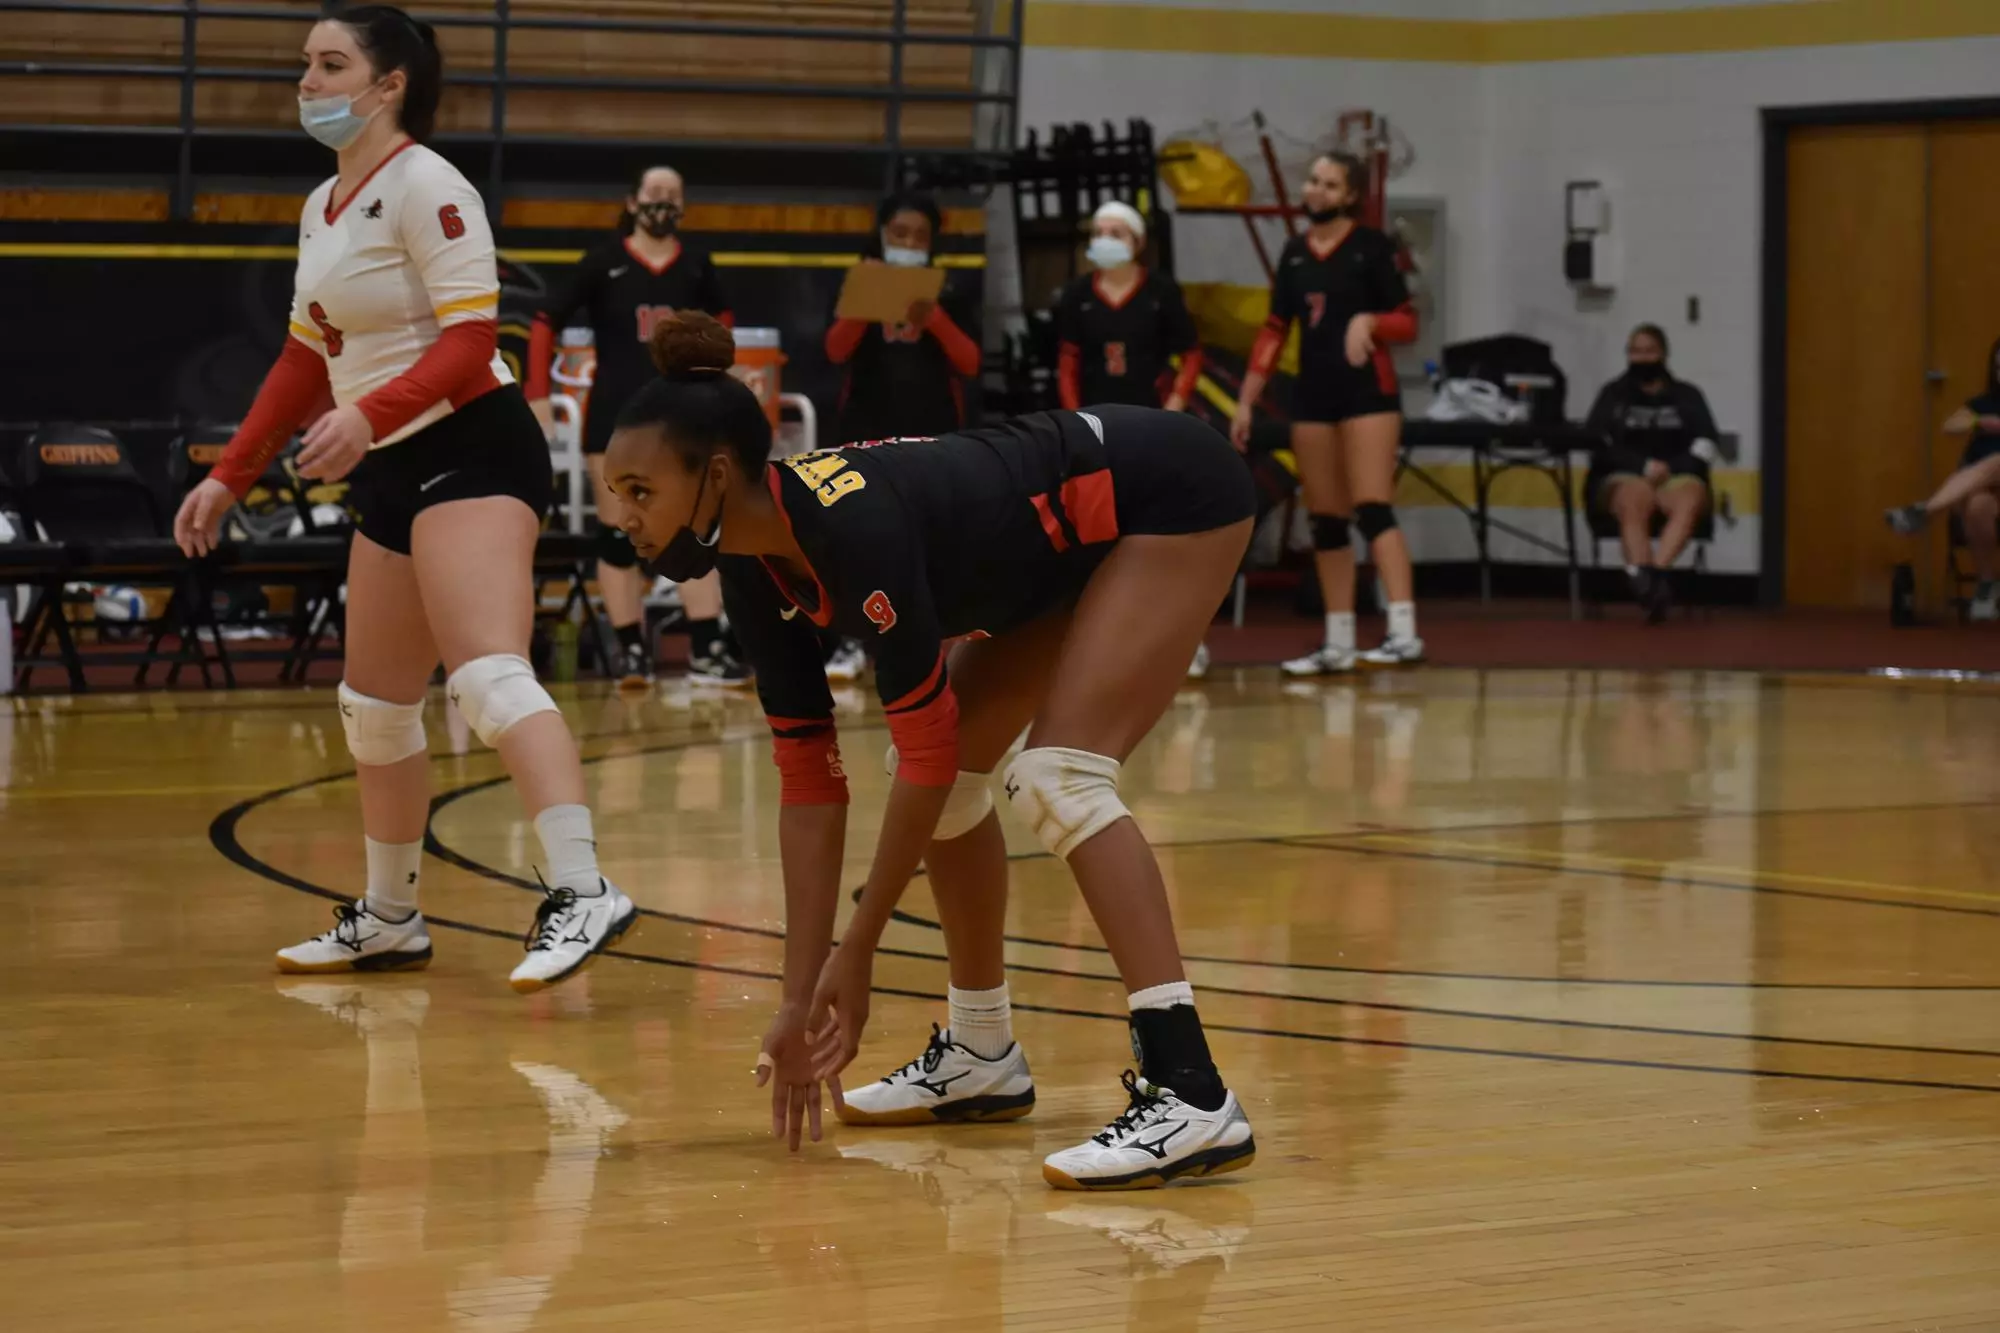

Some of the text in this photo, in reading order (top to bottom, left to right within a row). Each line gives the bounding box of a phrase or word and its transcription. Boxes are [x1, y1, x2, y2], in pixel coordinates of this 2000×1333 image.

[438, 203, 465, 240] 6
[1305, 292, 1326, 328] 7
[308, 301, 343, 357] 6
[40, 443, 121, 466] GRIFFINS
[862, 590, 897, 634] 9
